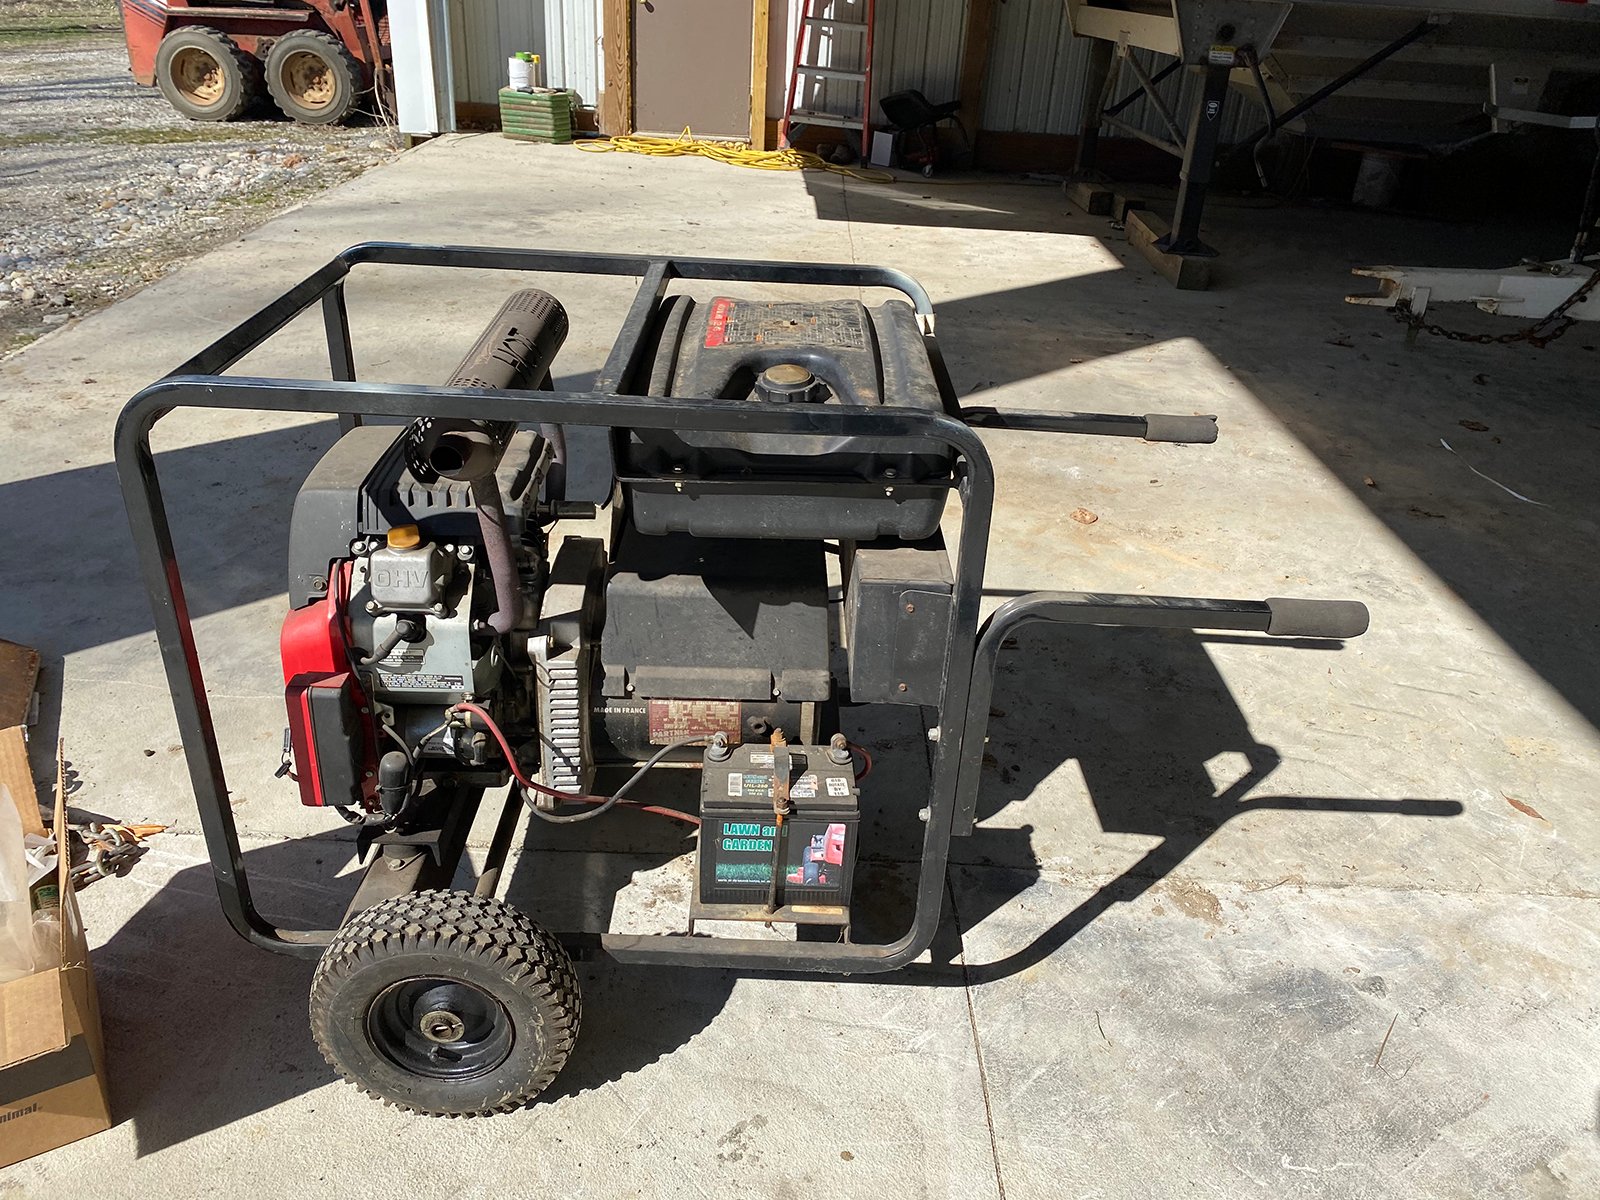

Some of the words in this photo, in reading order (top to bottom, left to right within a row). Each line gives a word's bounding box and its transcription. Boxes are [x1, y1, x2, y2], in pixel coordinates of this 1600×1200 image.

[375, 569, 430, 589] OHV
[723, 823, 760, 836] LAWN
[723, 838, 773, 852] GARDEN
